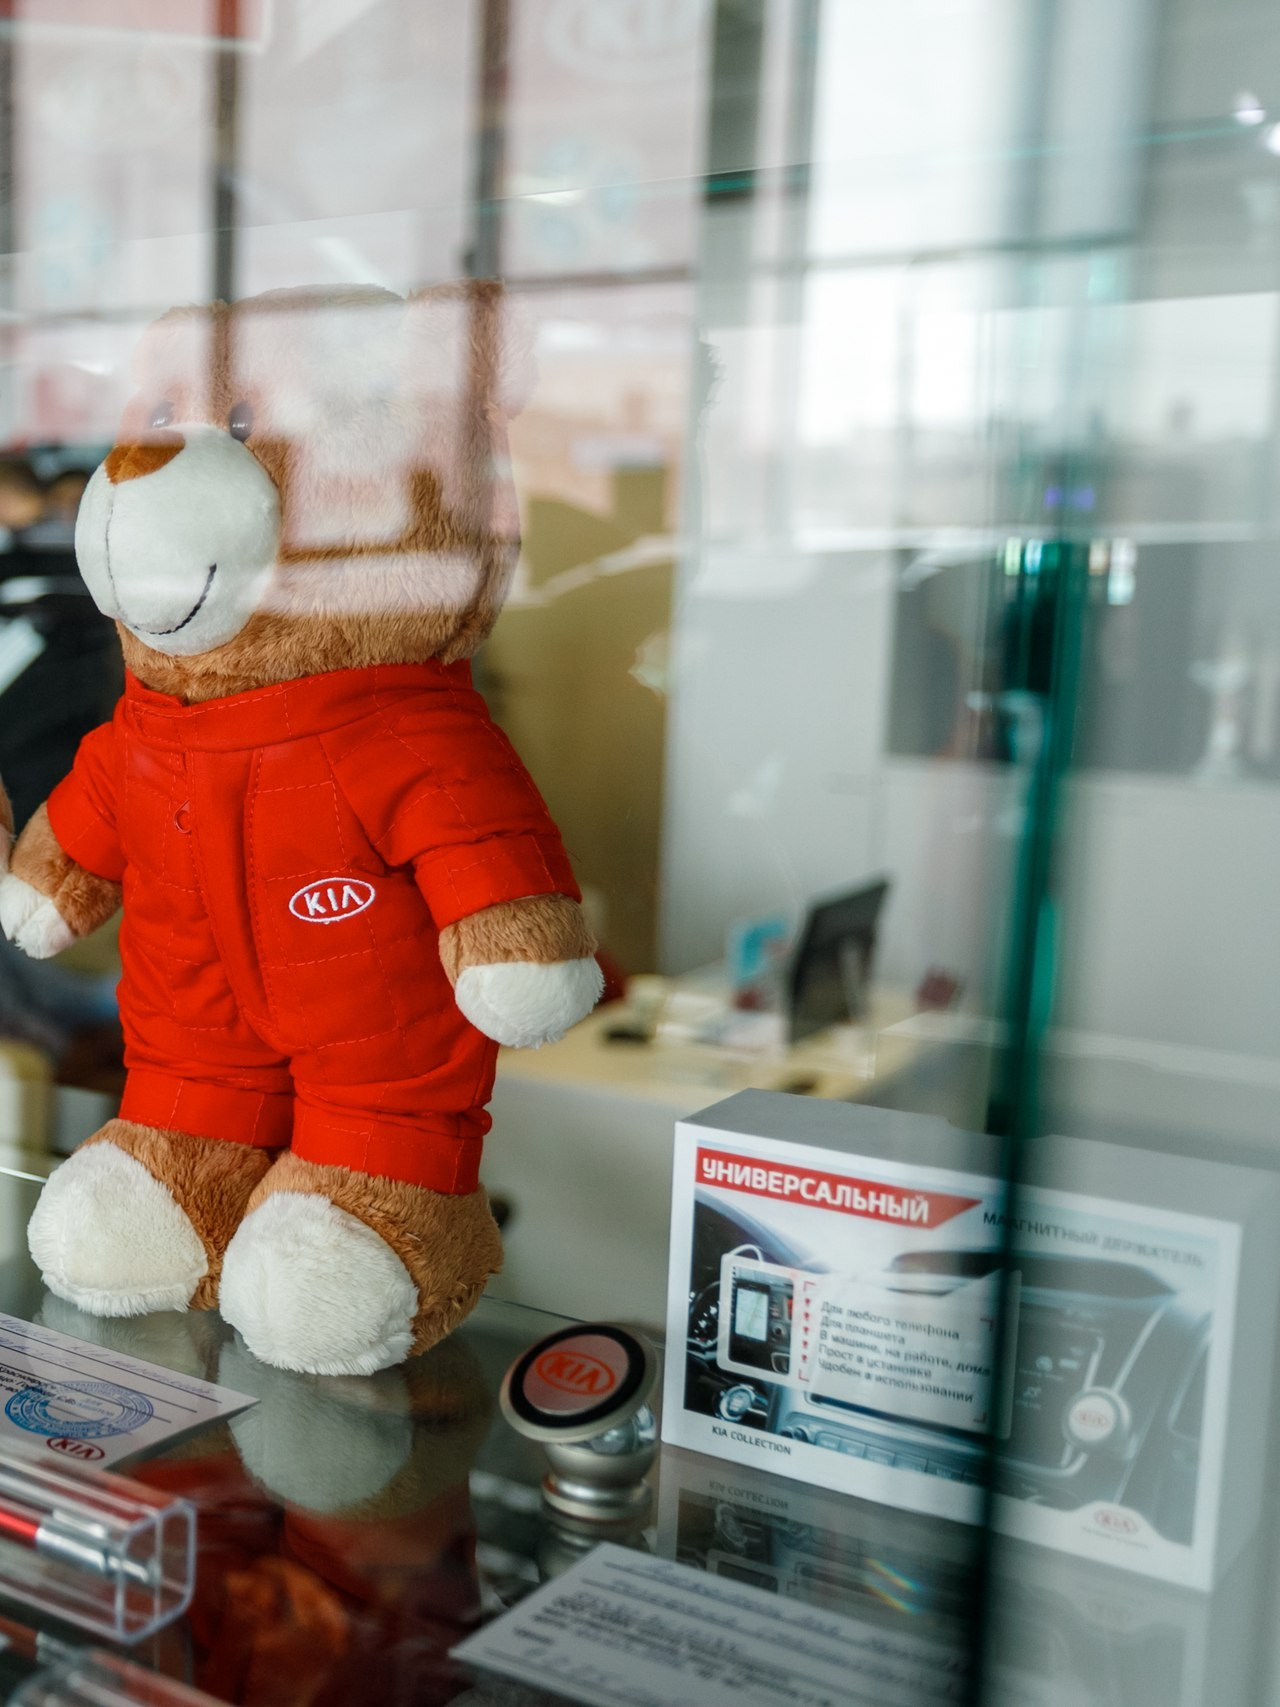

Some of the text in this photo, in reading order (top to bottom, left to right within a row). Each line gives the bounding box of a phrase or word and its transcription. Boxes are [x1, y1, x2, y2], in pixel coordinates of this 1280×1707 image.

[303, 884, 364, 916] KIA
[701, 1157, 930, 1224] УНИВЕРСАЛЬНЫЙ
[1101, 1234, 1205, 1268] ДЕРЖАТЕЛЬ
[819, 1316, 905, 1345] Для планшета
[820, 1301, 960, 1341] Для любого телефона
[818, 1343, 854, 1361] Прост
[866, 1357, 933, 1379] установке
[819, 1329, 828, 1341] В
[885, 1347, 901, 1358] на
[955, 1361, 991, 1377] дома
[547, 1355, 602, 1392] KIA
[818, 1357, 862, 1378] Удобен
[874, 1374, 975, 1403] использовании
[55, 1438, 98, 1460] KIA
[711, 1425, 792, 1456] KIA COLLECTION
